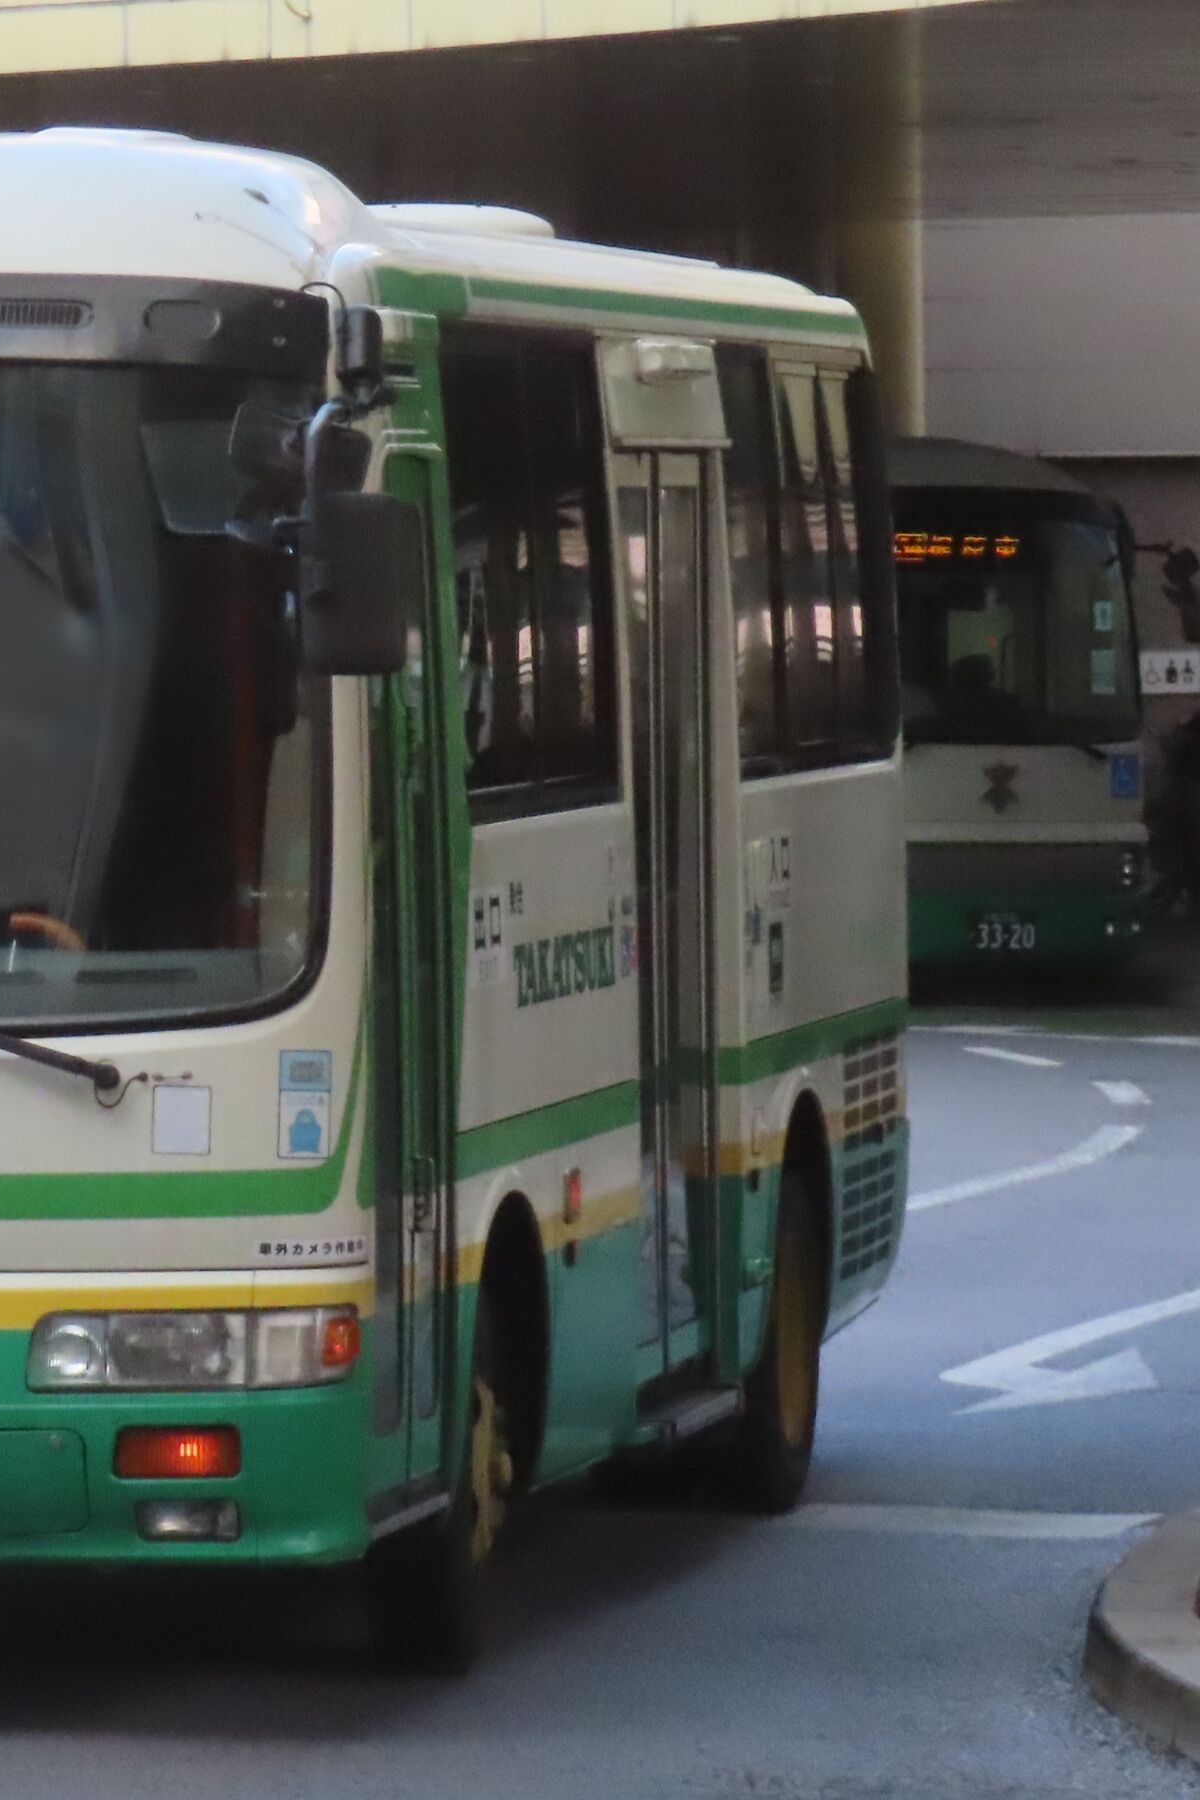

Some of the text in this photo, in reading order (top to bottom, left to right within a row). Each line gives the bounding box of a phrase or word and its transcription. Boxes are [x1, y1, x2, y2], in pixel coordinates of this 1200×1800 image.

[474, 895, 501, 950] 出口
[977, 923, 1036, 949] 33-20
[512, 925, 616, 1008] TAKATSUKI
